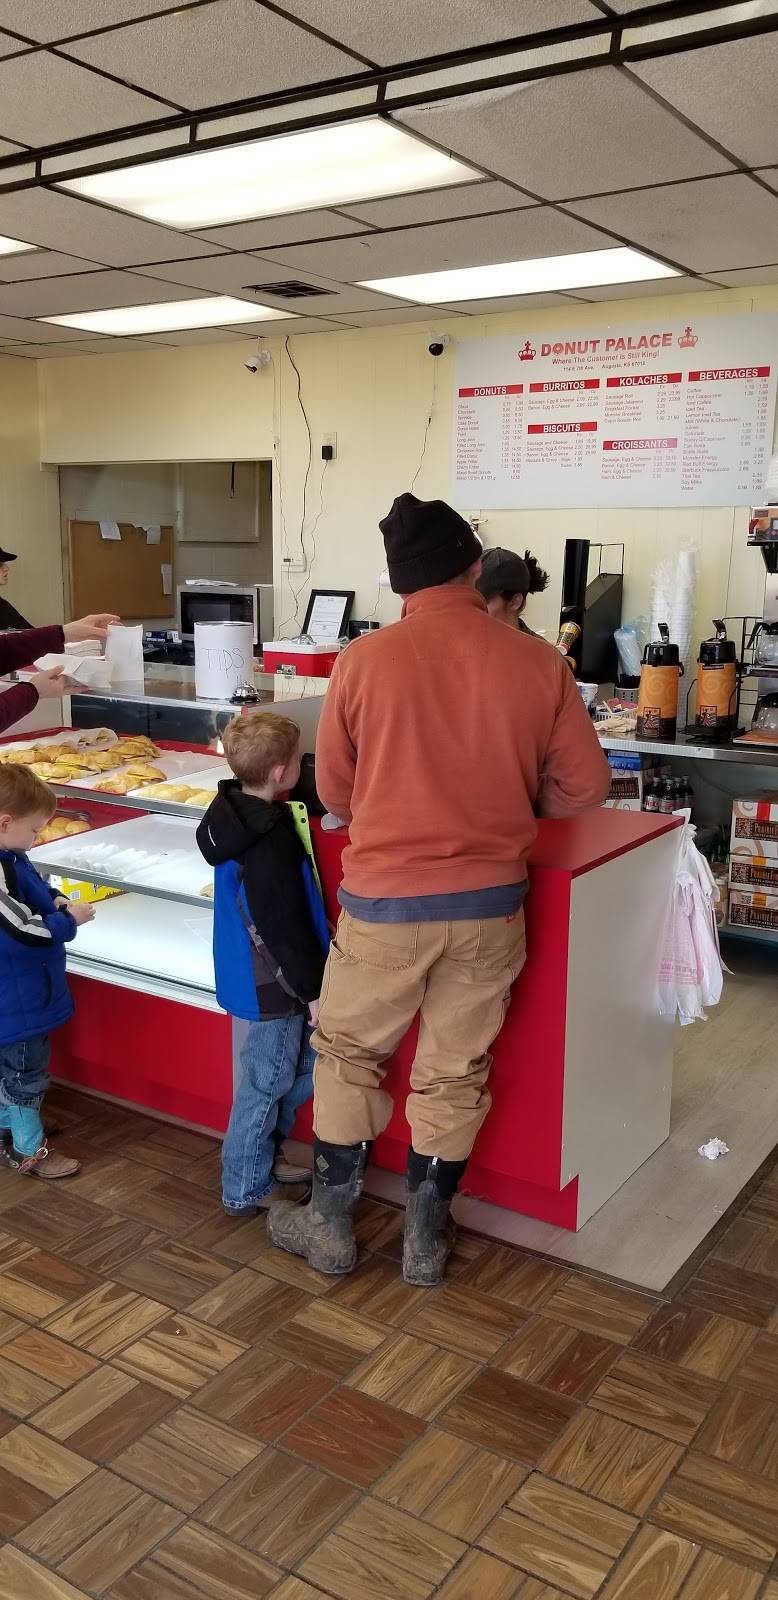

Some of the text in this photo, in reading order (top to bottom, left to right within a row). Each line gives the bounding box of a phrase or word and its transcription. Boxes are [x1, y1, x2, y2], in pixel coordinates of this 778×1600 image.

[540, 333, 673, 357] DONUT PALACE
[587, 355, 619, 363] Customer
[627, 352, 641, 360] Still
[642, 350, 660, 359] King!
[699, 368, 759, 380] BEVERAGES
[543, 381, 585, 391] BURRITOS
[619, 375, 668, 386] KOLACHES
[474, 387, 507, 396] DONUTS
[543, 423, 581, 433] BISCUITS
[611, 440, 668, 450] CROISSANTS
[204, 647, 246, 681] TIPS
